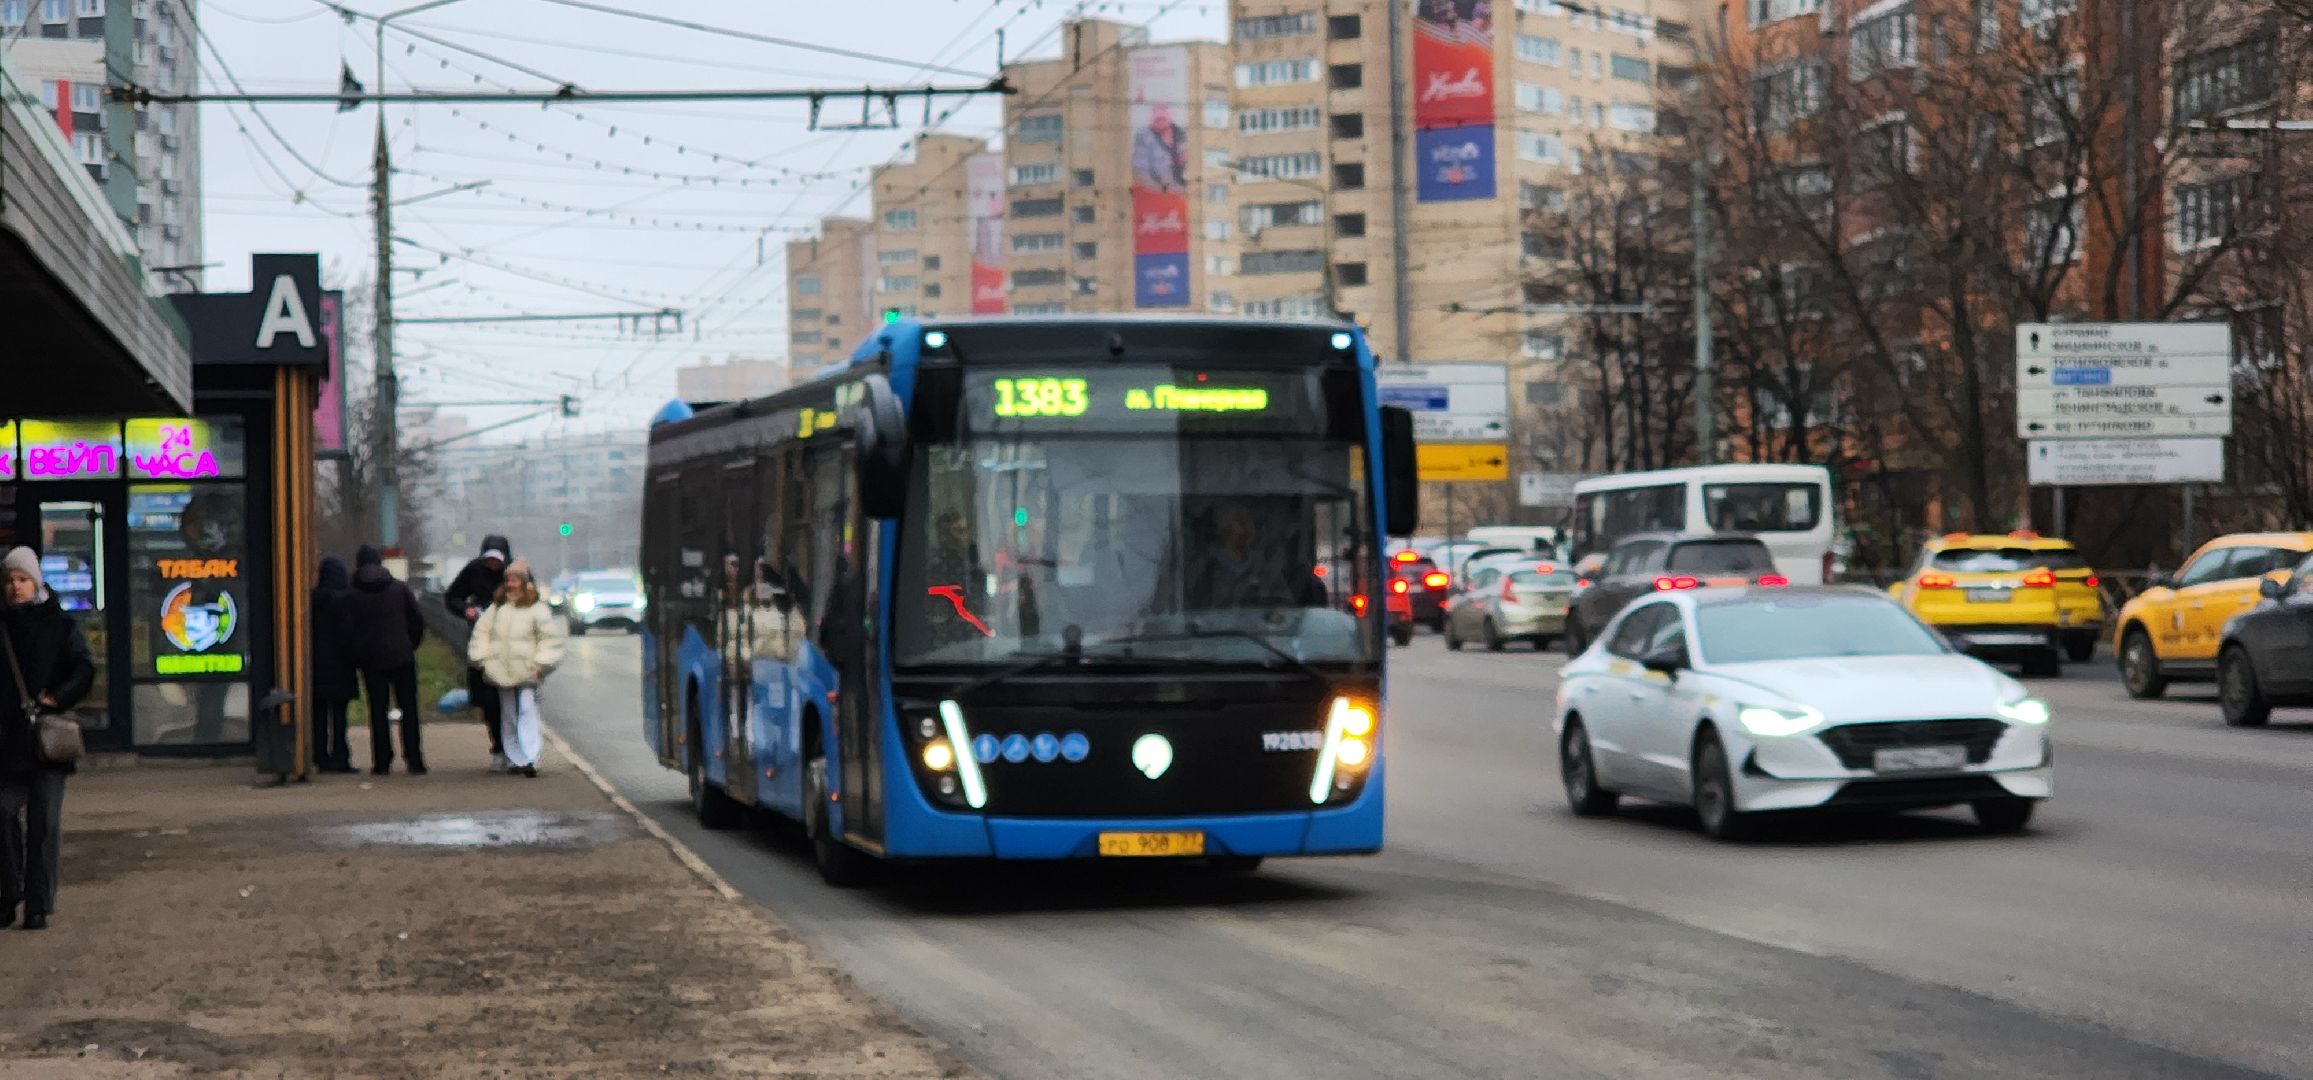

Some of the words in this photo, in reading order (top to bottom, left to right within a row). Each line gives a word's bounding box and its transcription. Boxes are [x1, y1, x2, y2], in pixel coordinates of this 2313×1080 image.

[994, 378, 1089, 416] 1383
[160, 424, 192, 450] 24
[29, 441, 115, 476] ВЕЙП
[135, 451, 220, 478] ЧАСА
[156, 559, 239, 579] ТАБАК
